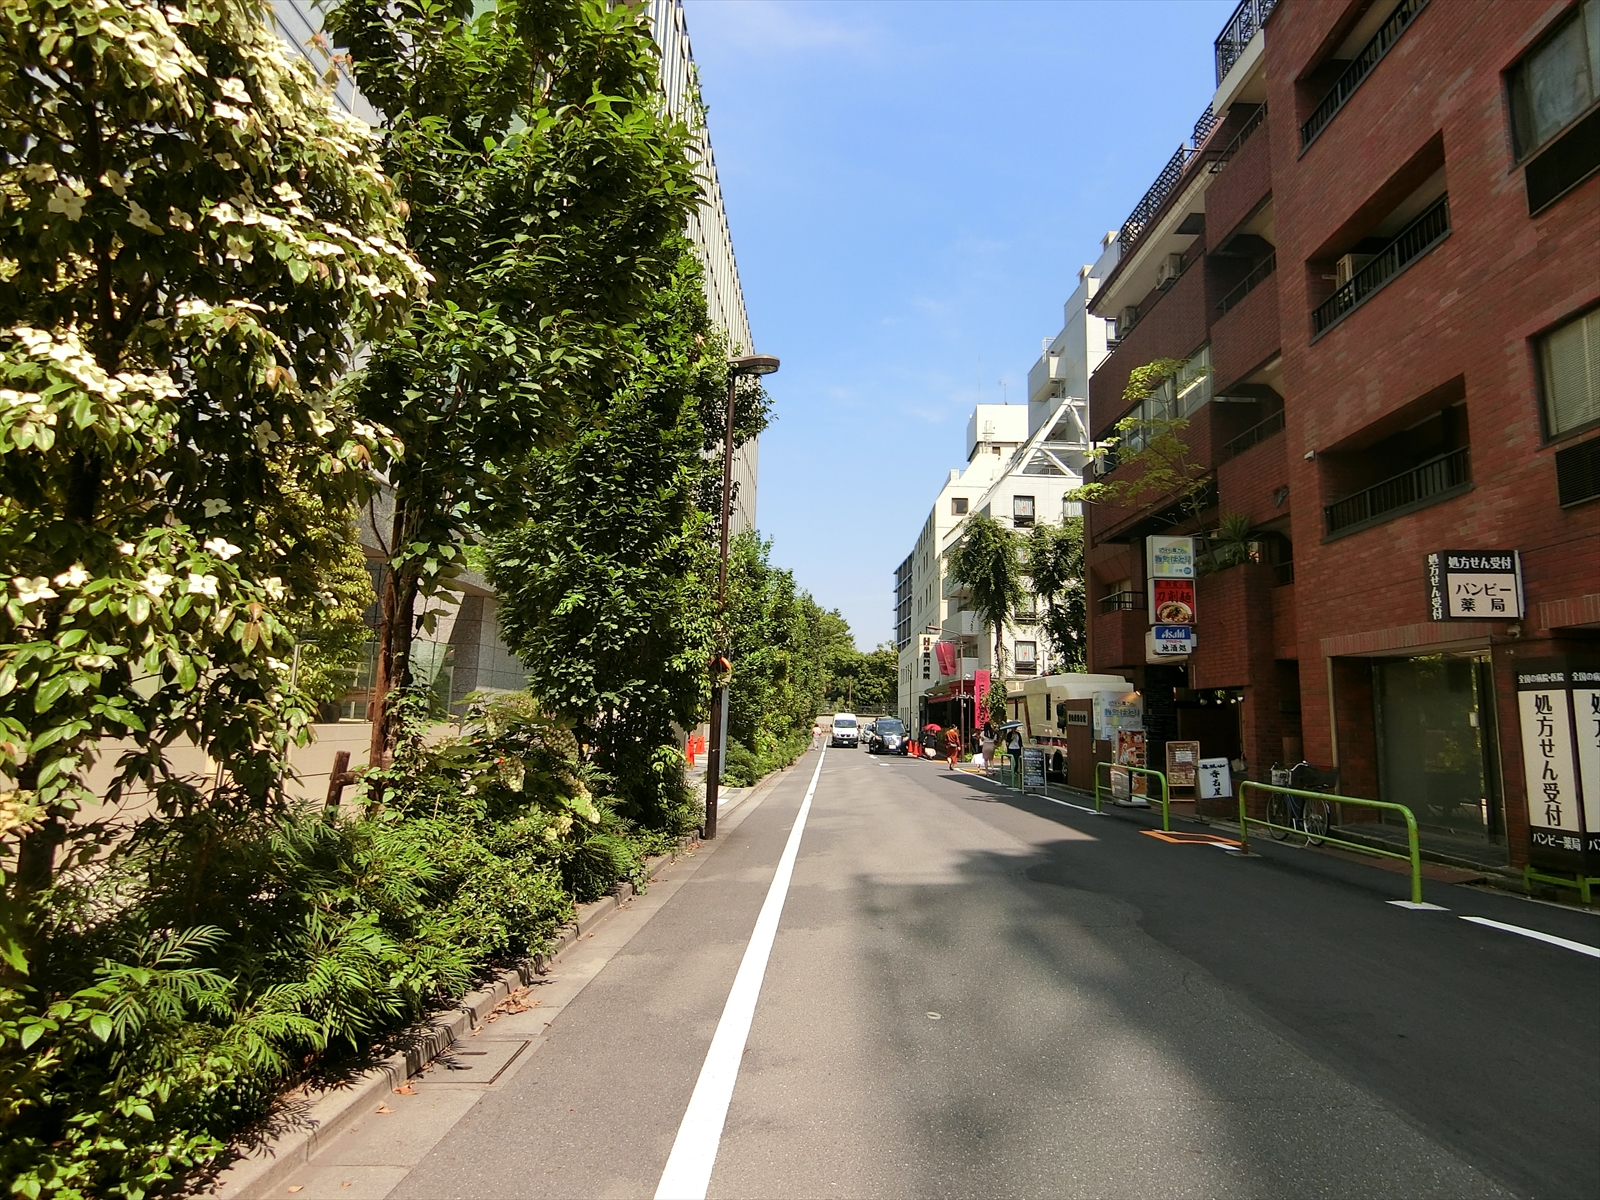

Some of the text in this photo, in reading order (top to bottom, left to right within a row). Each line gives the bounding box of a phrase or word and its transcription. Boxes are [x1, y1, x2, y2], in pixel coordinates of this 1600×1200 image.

[1448, 556, 1511, 569] 処方せん受付
[1428, 553, 1443, 620] 処方せん受付
[1455, 583, 1512, 597] バンビー
[1461, 598, 1505, 612] 薬局
[1161, 628, 1185, 639] Asahi
[1161, 644, 1187, 652] 地酒処
[1534, 693, 1562, 827] 処方せん受付
[1532, 832, 1581, 852] バンビー薬局
